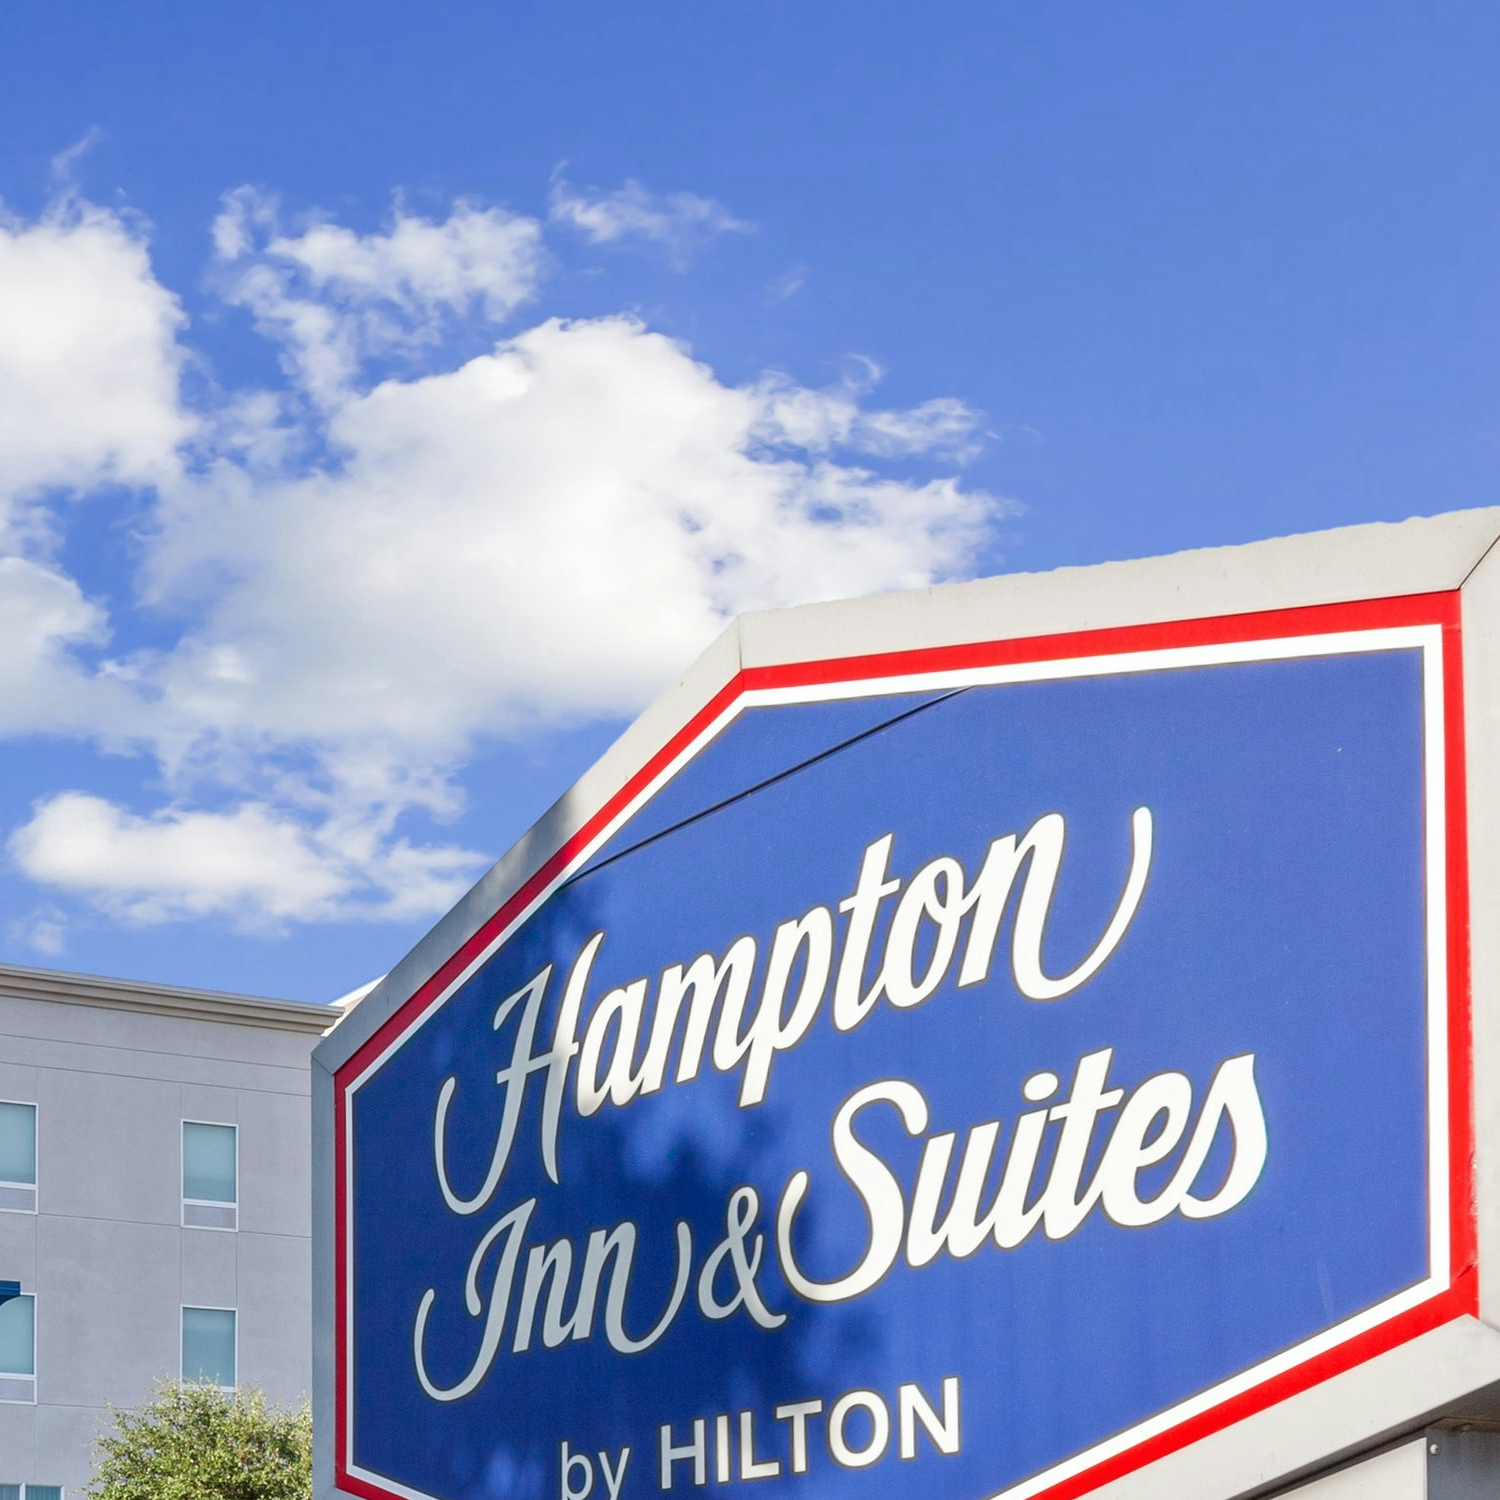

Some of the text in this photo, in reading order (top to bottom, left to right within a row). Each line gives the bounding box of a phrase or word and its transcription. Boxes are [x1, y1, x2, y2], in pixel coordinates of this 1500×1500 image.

[433, 806, 1154, 1216] Hampton
[413, 1047, 1268, 1402] Inn & Suites
[660, 1376, 960, 1491] HILTON
